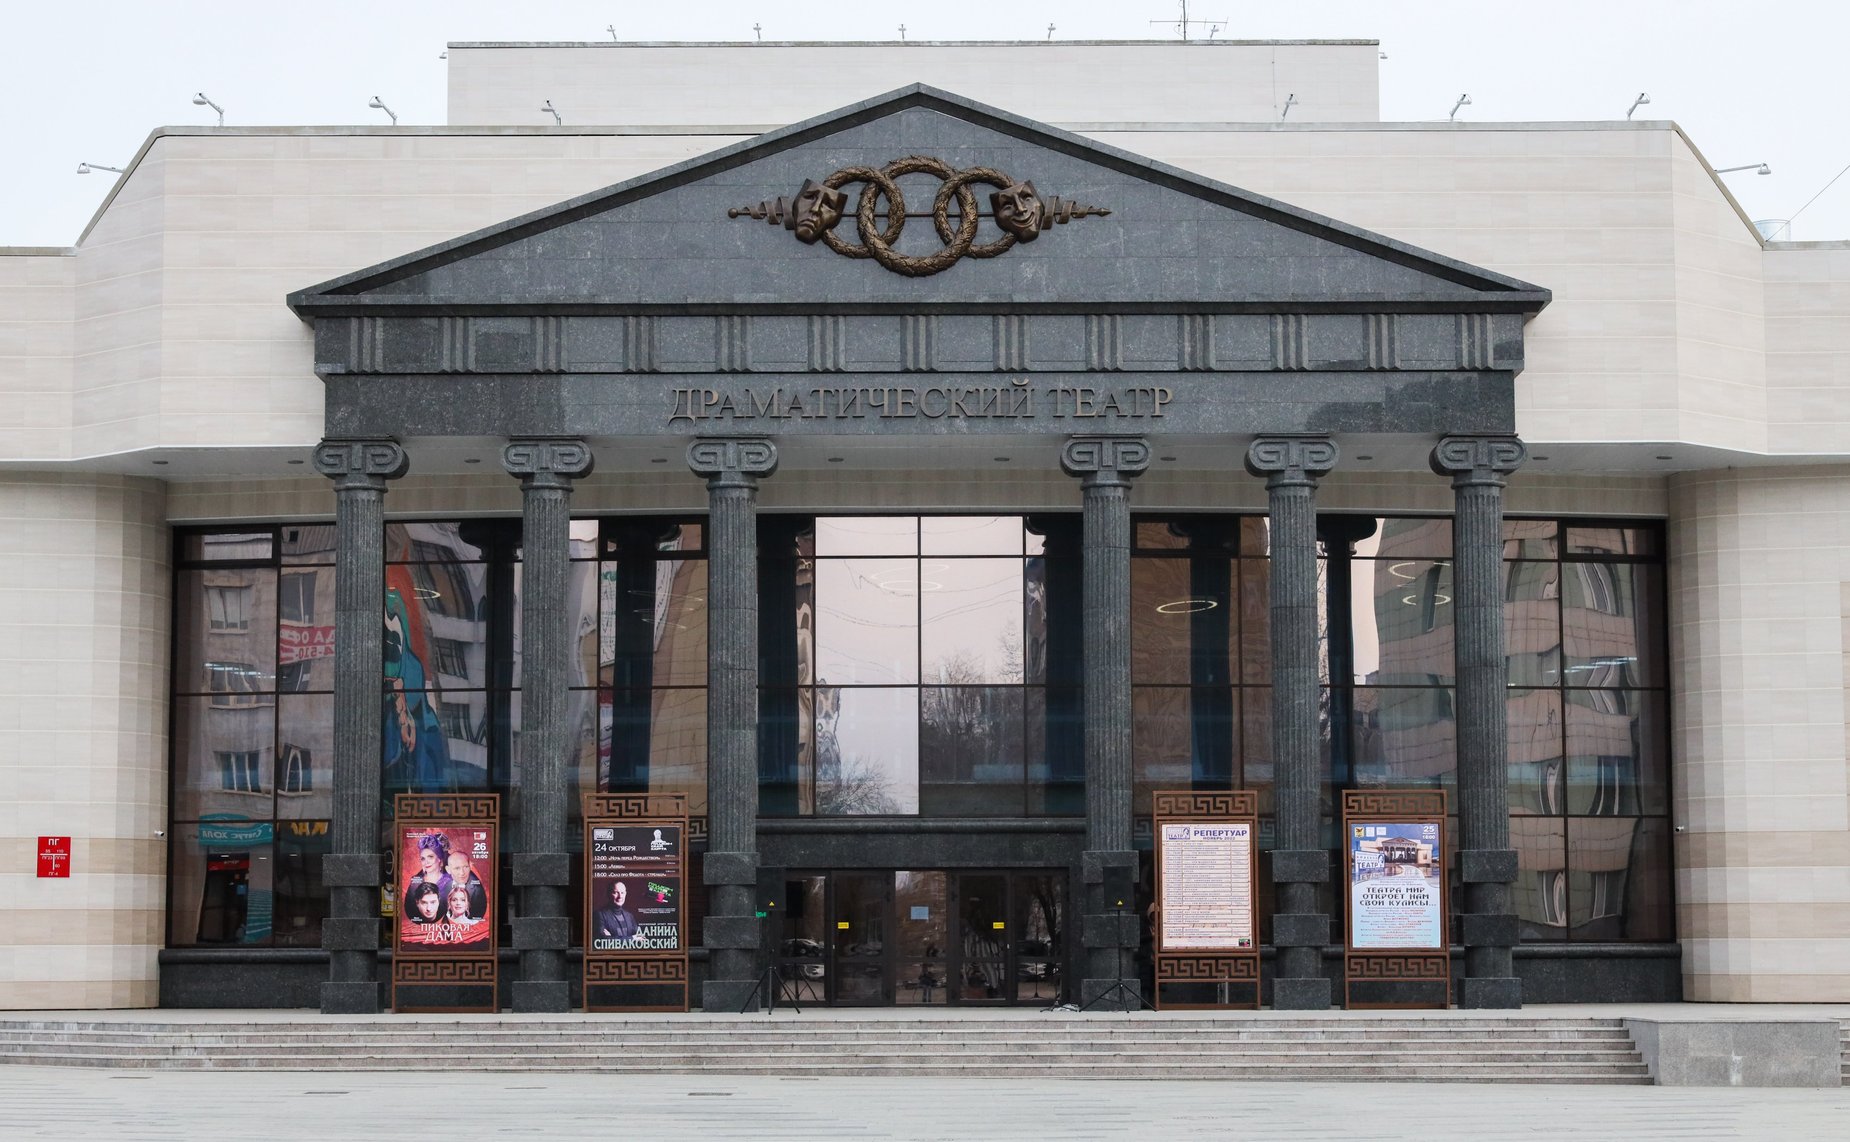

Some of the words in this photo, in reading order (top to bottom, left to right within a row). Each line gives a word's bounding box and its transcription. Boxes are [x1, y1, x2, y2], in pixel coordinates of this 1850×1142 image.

[668, 377, 1035, 426] ДРАМАТИЧЕСКИЙ
[1046, 387, 1173, 418] ТЕАТР
[473, 842, 487, 851] 26
[595, 843, 607, 852] 24
[421, 923, 470, 932] ПИКОВАЯ
[636, 925, 678, 937] ДАНИИЛ
[424, 931, 463, 942] ДАМА
[594, 936, 678, 950] СПИВАКОВСКИЙ
